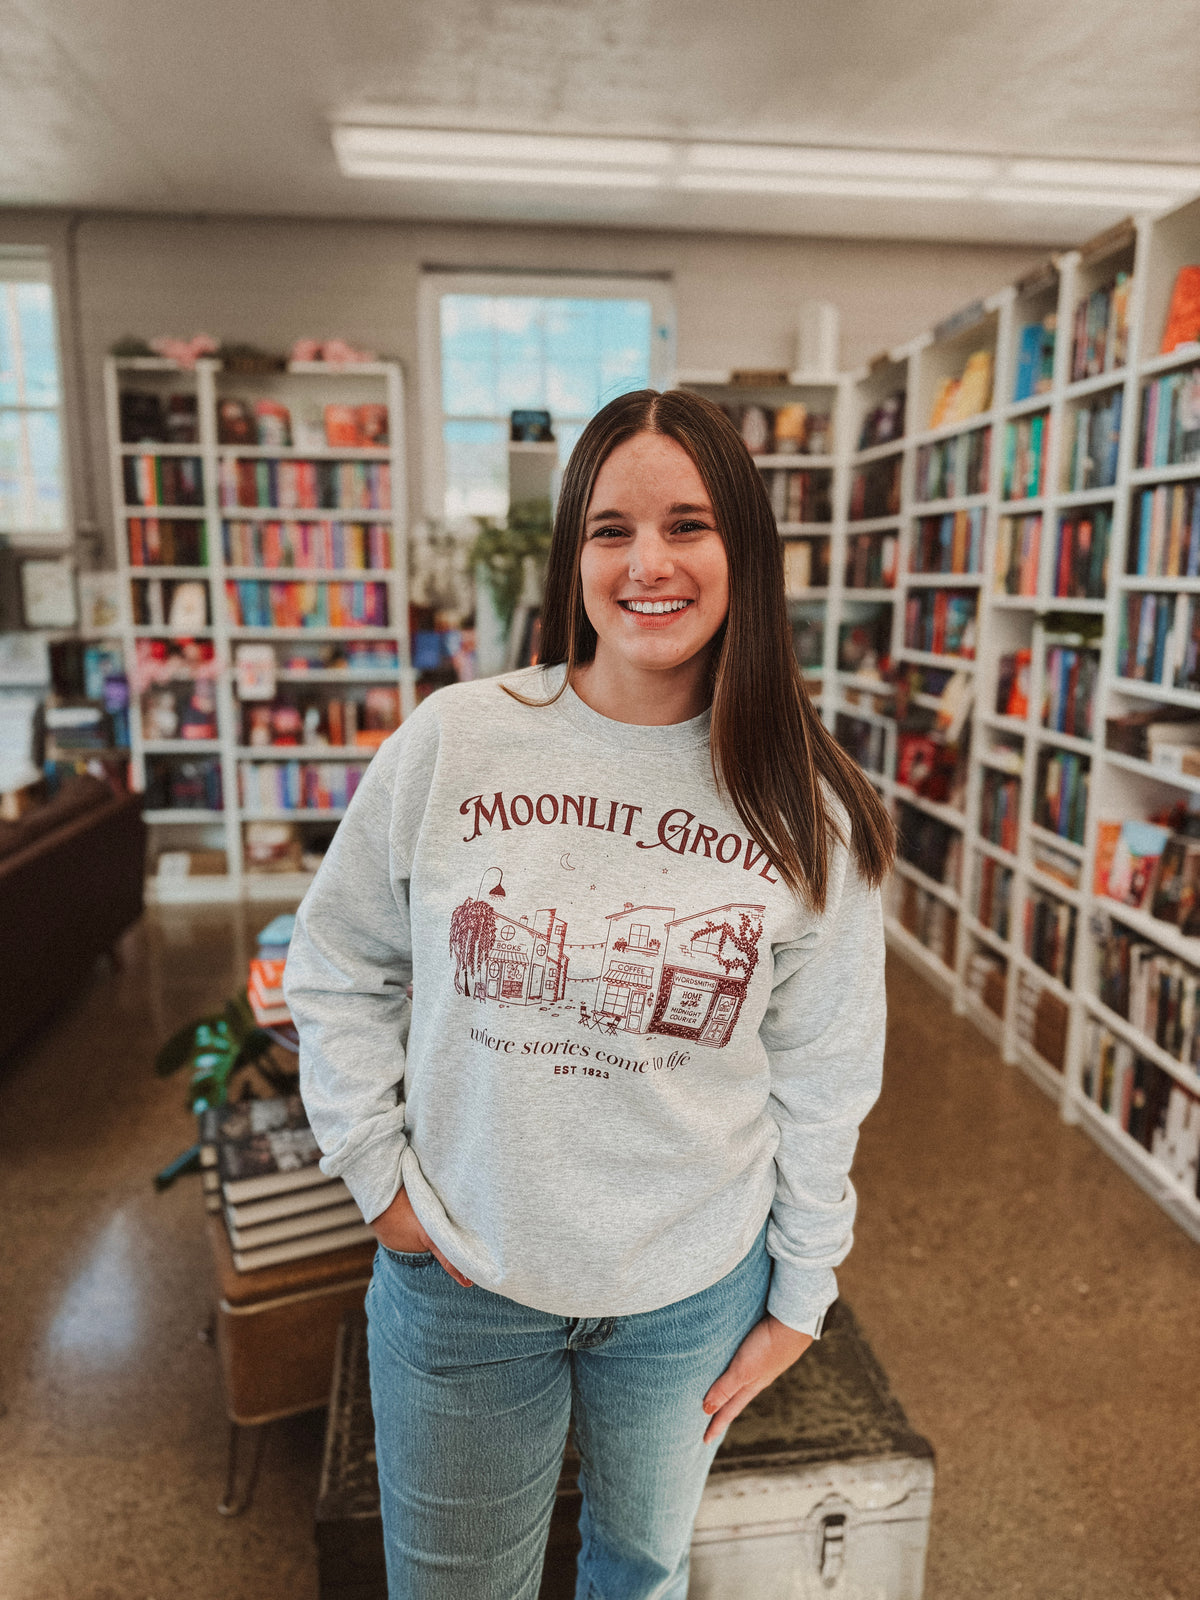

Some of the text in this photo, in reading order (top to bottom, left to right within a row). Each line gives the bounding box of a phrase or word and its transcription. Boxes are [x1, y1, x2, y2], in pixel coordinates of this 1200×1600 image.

[459, 791, 643, 843] MOONLIT
[496, 942, 522, 951] BOOKS
[617, 963, 646, 975] COFFEE
[675, 975, 715, 989] WORDSMITHS
[682, 991, 703, 1001] HOME
[670, 1007, 702, 1018] MIDNIGHT
[669, 1014, 697, 1024] COURIER
[469, 1027, 515, 1053] where
[520, 1039, 591, 1057] stories
[595, 1050, 649, 1074] come
[666, 1050, 691, 1071] life
[553, 1065, 610, 1080] EST 1823
